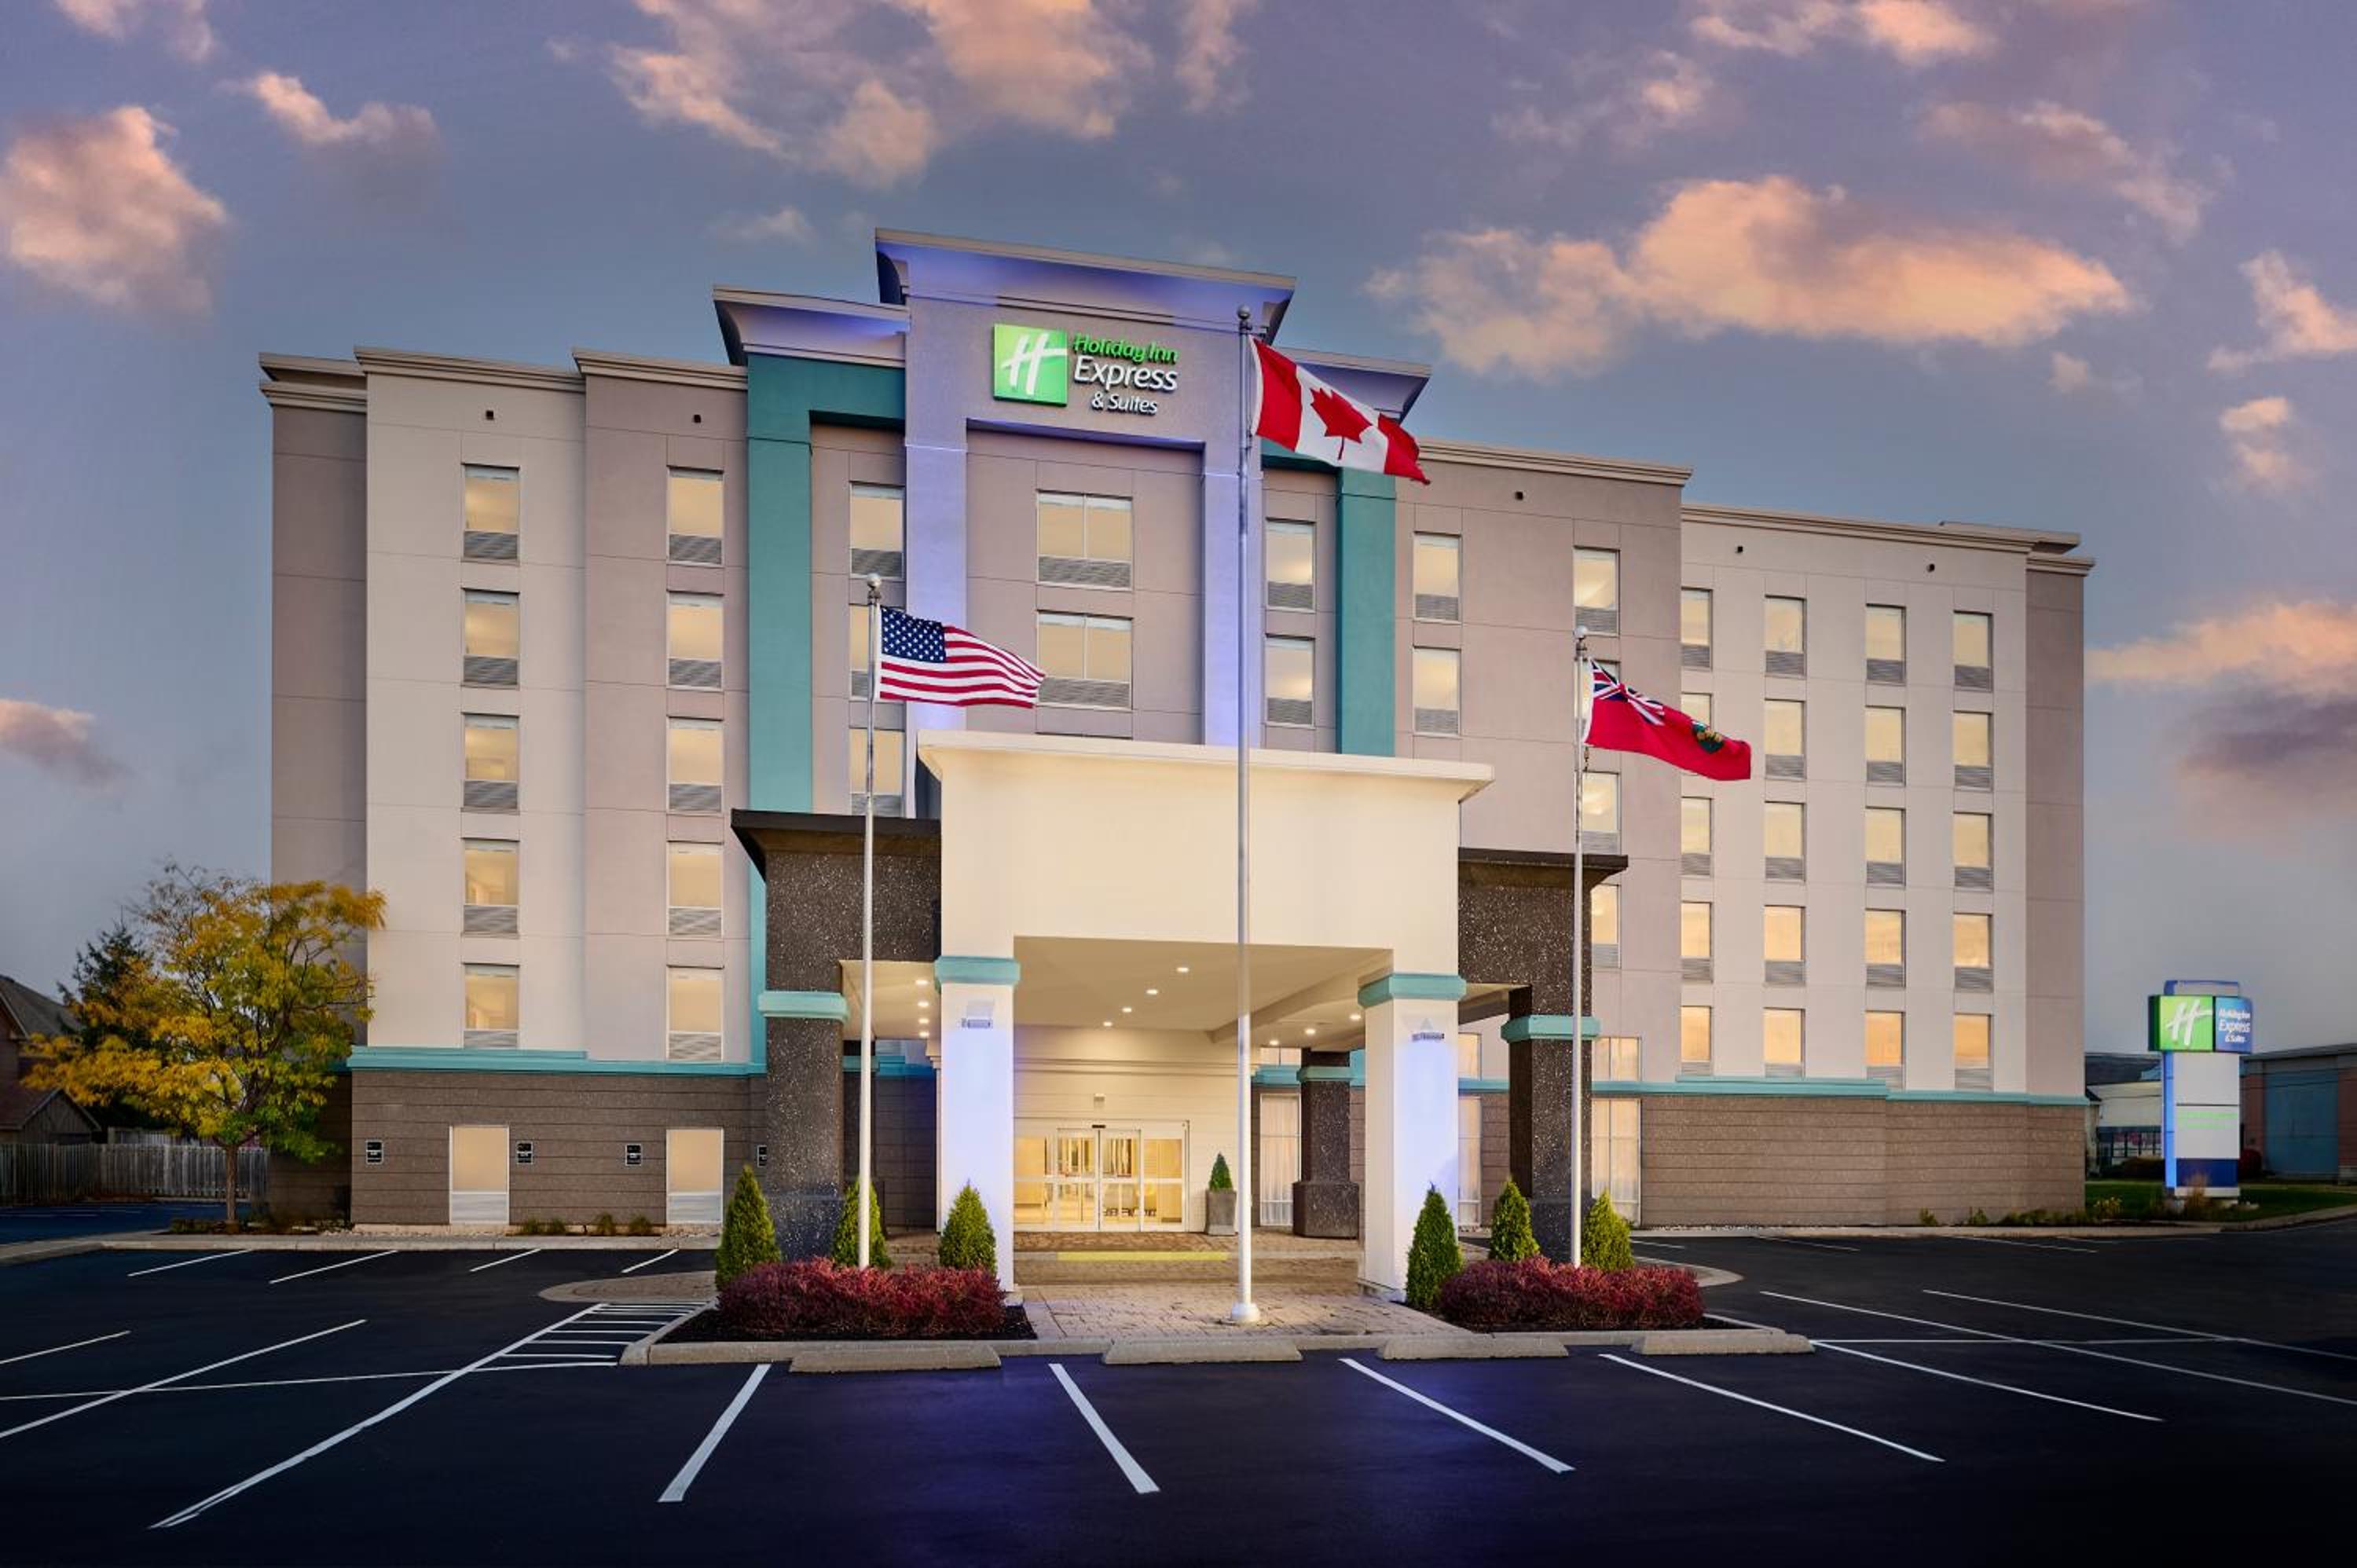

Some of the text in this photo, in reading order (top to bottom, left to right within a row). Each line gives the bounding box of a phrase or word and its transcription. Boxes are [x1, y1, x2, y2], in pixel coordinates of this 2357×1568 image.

[1073, 332, 1178, 363] Holiday Inn
[1074, 354, 1178, 392] Express
[1091, 391, 1157, 415] & Suites
